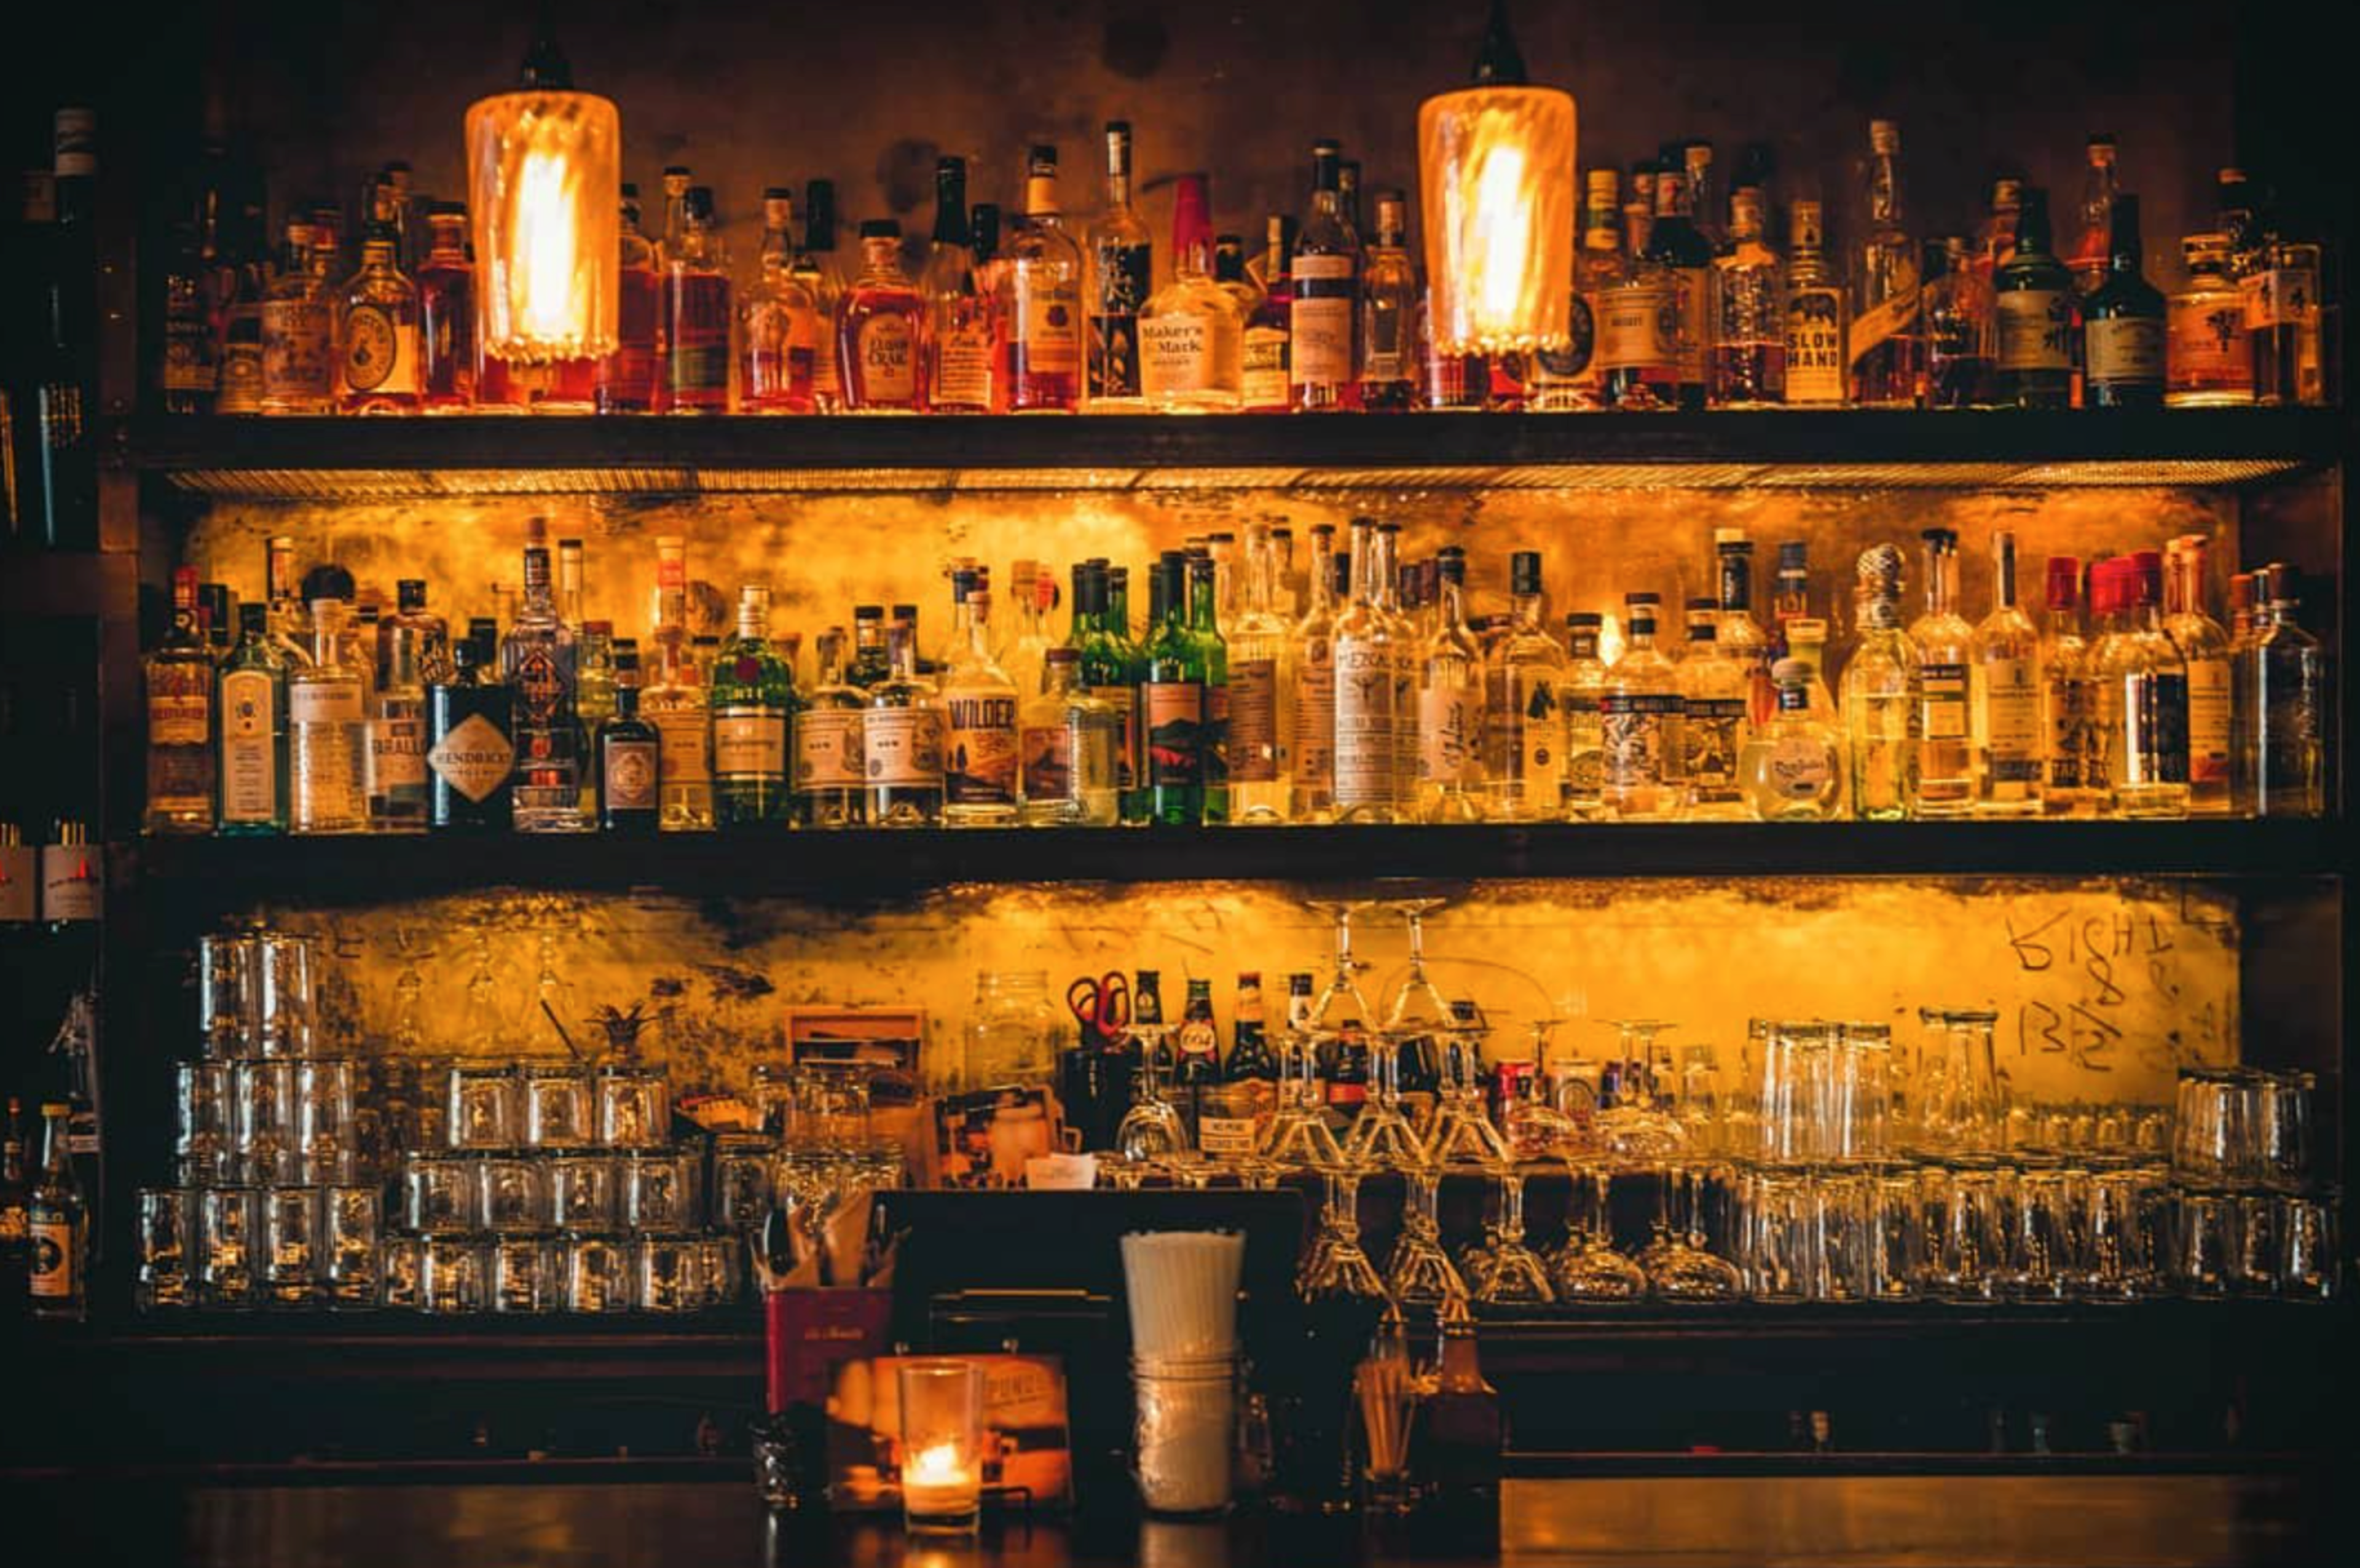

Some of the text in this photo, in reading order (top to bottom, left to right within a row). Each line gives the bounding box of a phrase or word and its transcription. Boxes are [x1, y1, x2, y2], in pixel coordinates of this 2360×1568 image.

[1158, 339, 1203, 355] Mark
[1787, 332, 1838, 348] SLOW
[1787, 351, 1838, 367] HAND
[948, 699, 1015, 731] WILDER
